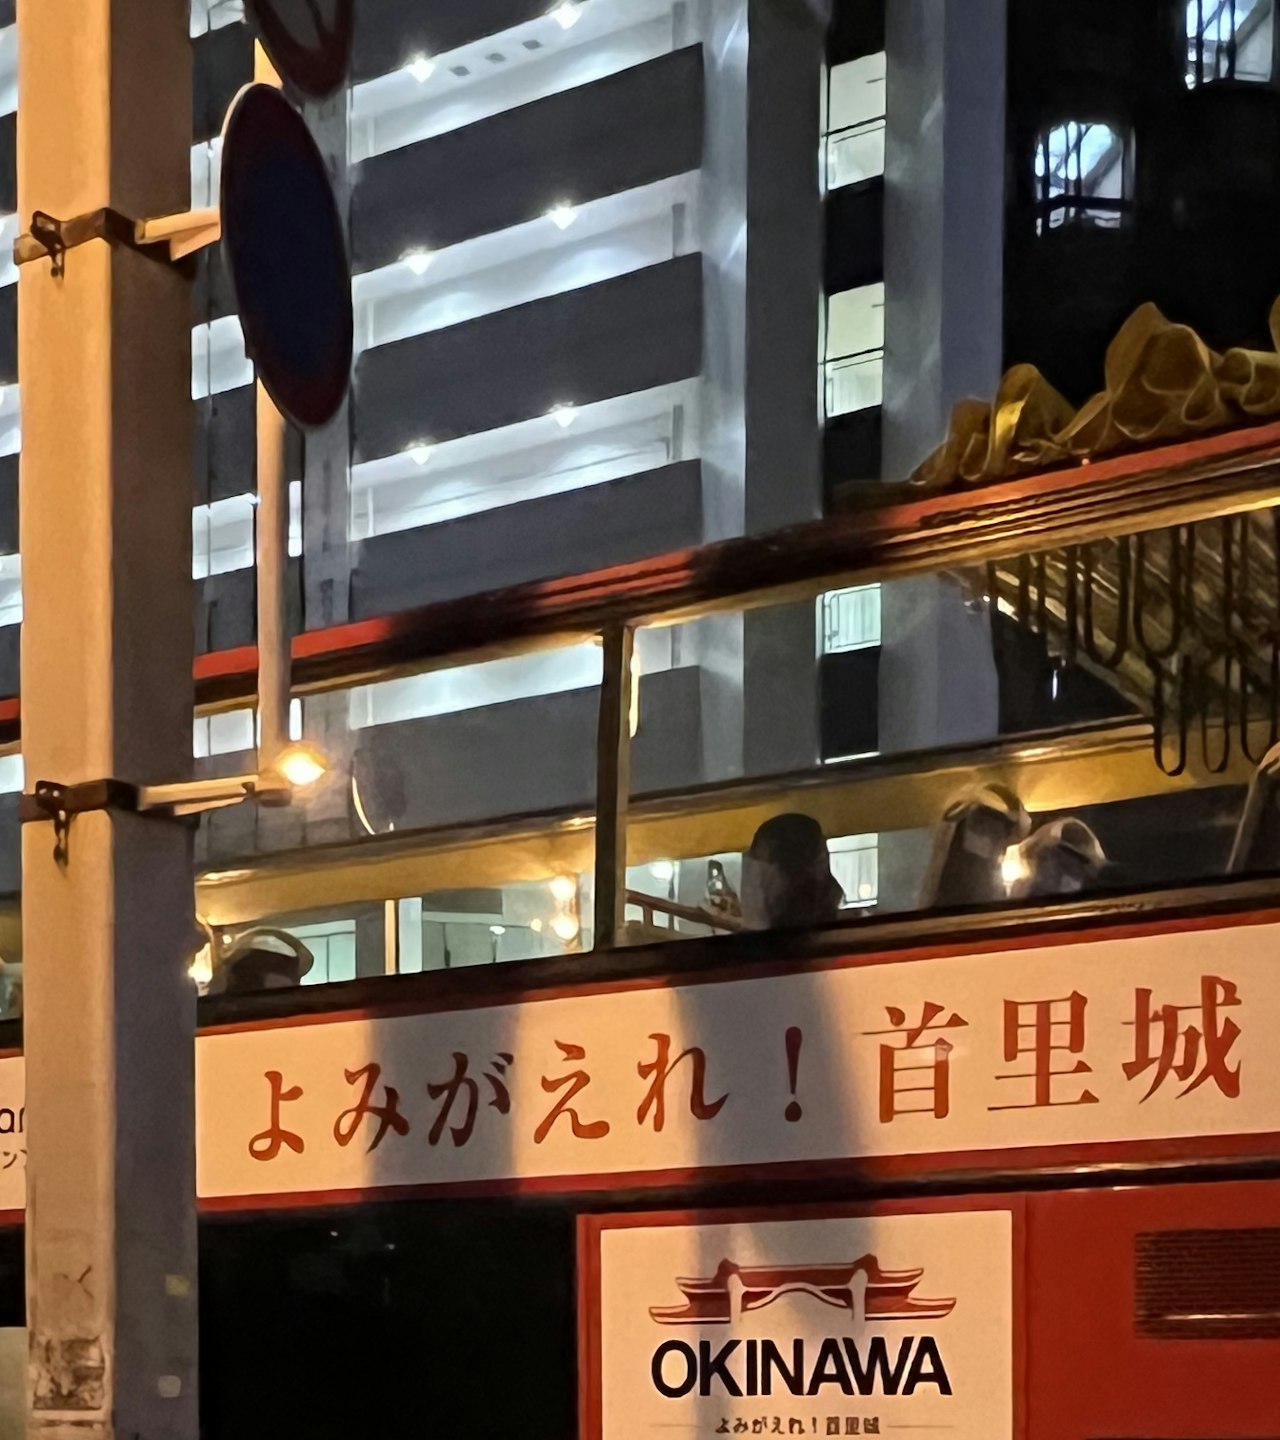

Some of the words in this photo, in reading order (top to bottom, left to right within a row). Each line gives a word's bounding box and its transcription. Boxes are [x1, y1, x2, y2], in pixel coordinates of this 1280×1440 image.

[247, 974, 1243, 1162] よみがえれ！首里城
[651, 1336, 952, 1398] OKINAWA
